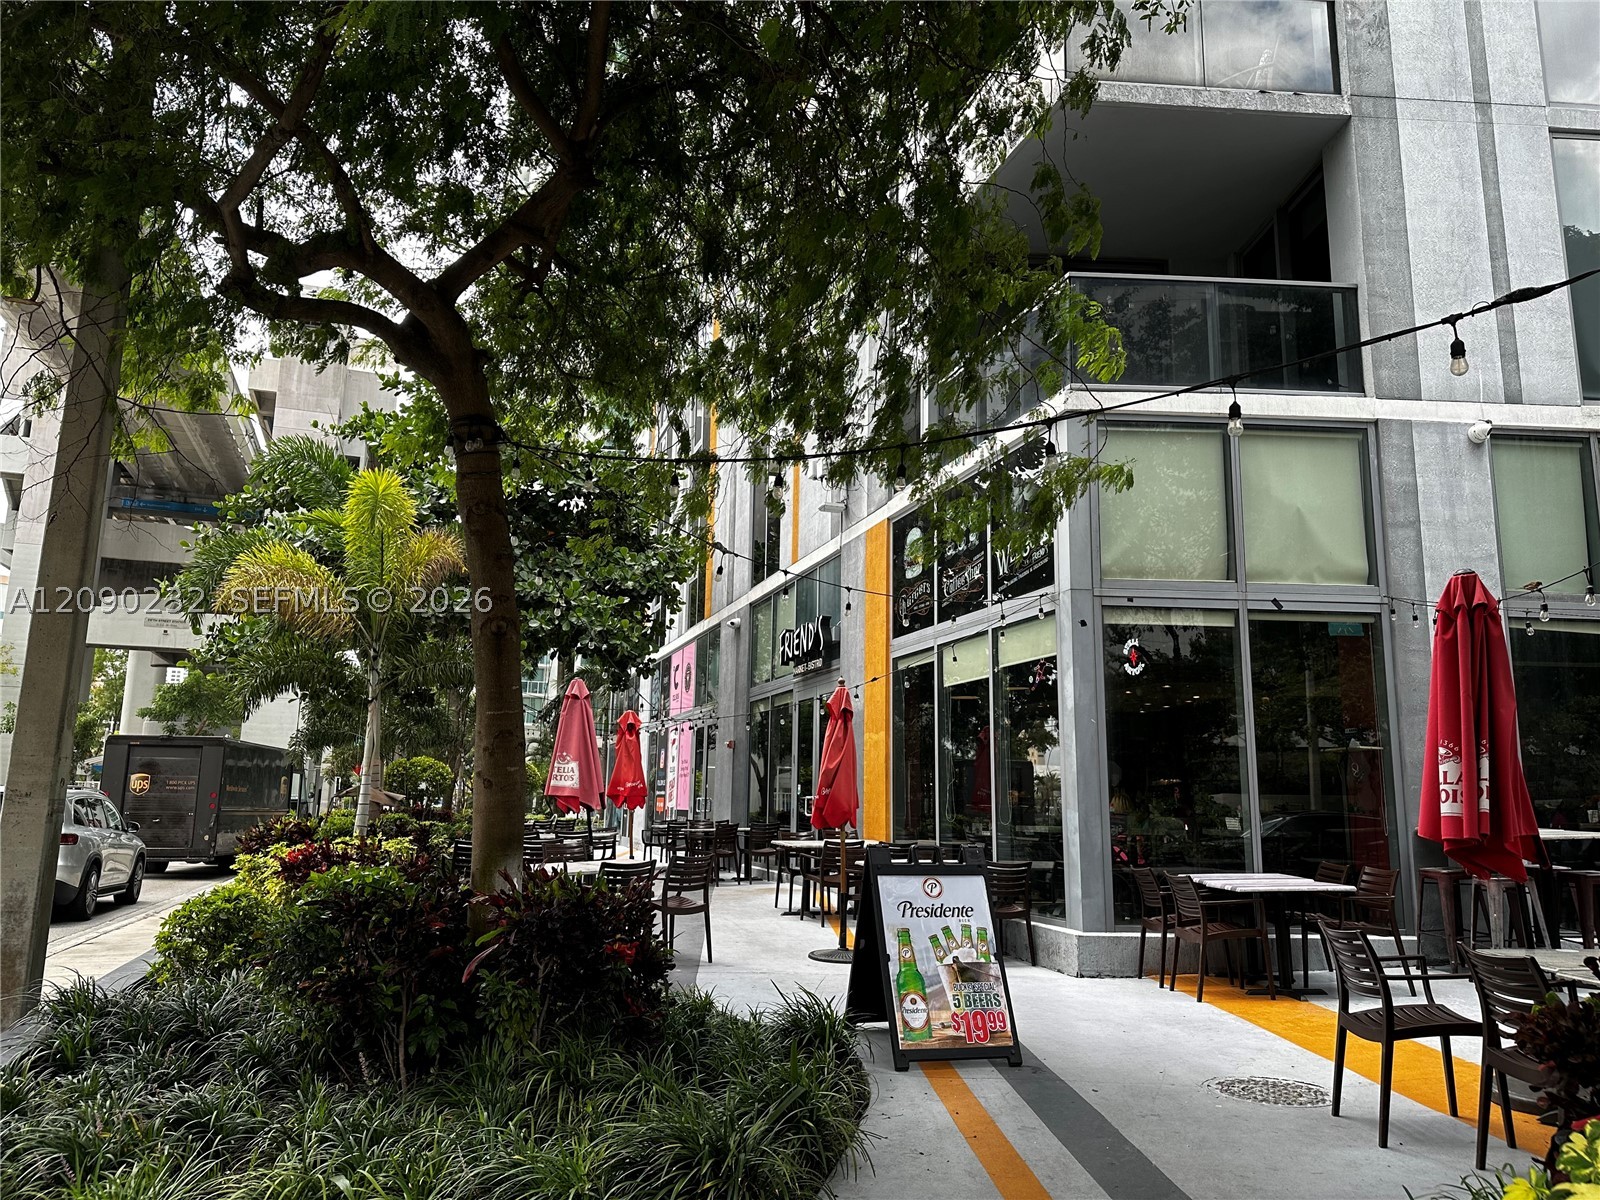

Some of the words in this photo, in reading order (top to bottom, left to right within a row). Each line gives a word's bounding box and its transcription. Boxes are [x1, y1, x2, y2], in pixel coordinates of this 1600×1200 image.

[779, 615, 824, 665] FRIEND'S
[131, 780, 149, 792] ups
[897, 900, 974, 918] Presidente
[952, 993, 962, 1009] 5
[963, 992, 1002, 1008] BEERS
